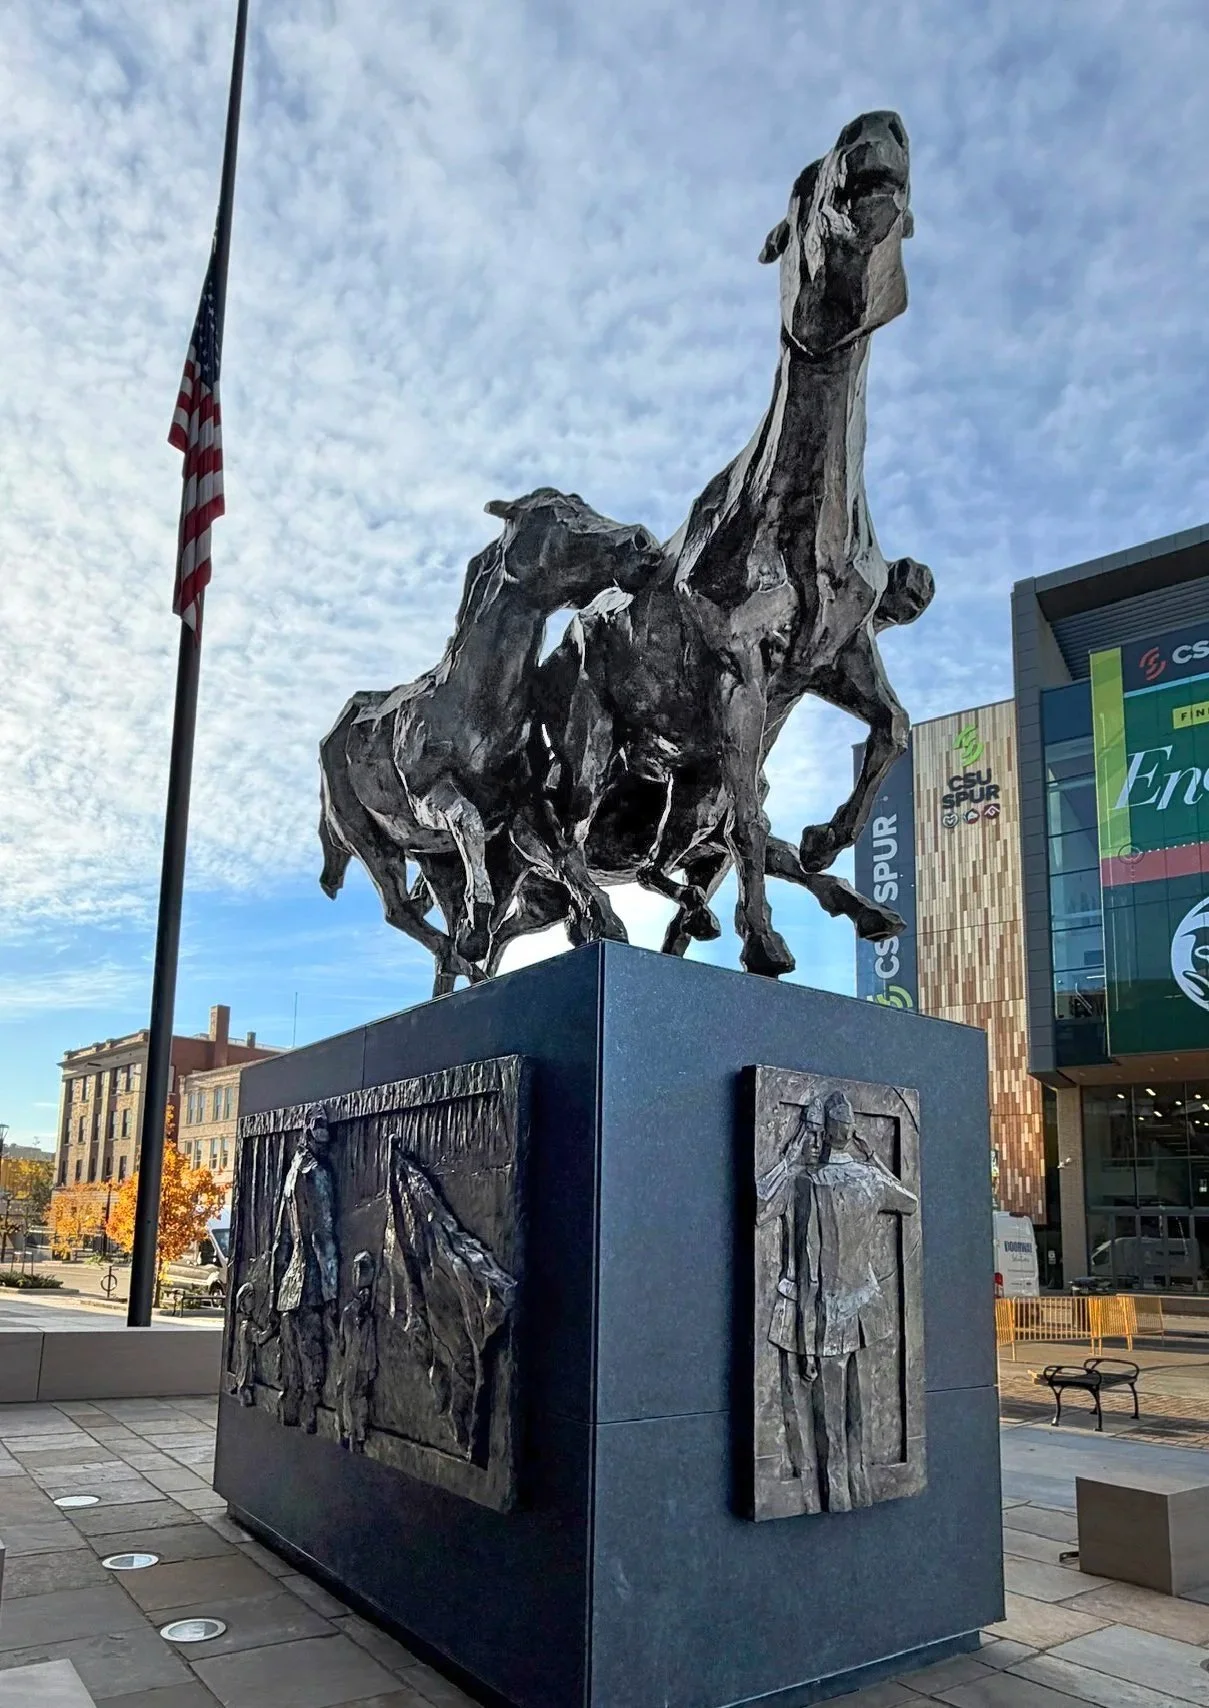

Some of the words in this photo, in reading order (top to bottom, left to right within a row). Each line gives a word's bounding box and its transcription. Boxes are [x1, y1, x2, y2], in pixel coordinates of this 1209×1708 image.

[942, 784, 1000, 809] SPUR
[949, 768, 992, 791] CSU
[1108, 745, 1209, 811] En
[872, 814, 899, 903] SPUR
[874, 934, 900, 979] CS
